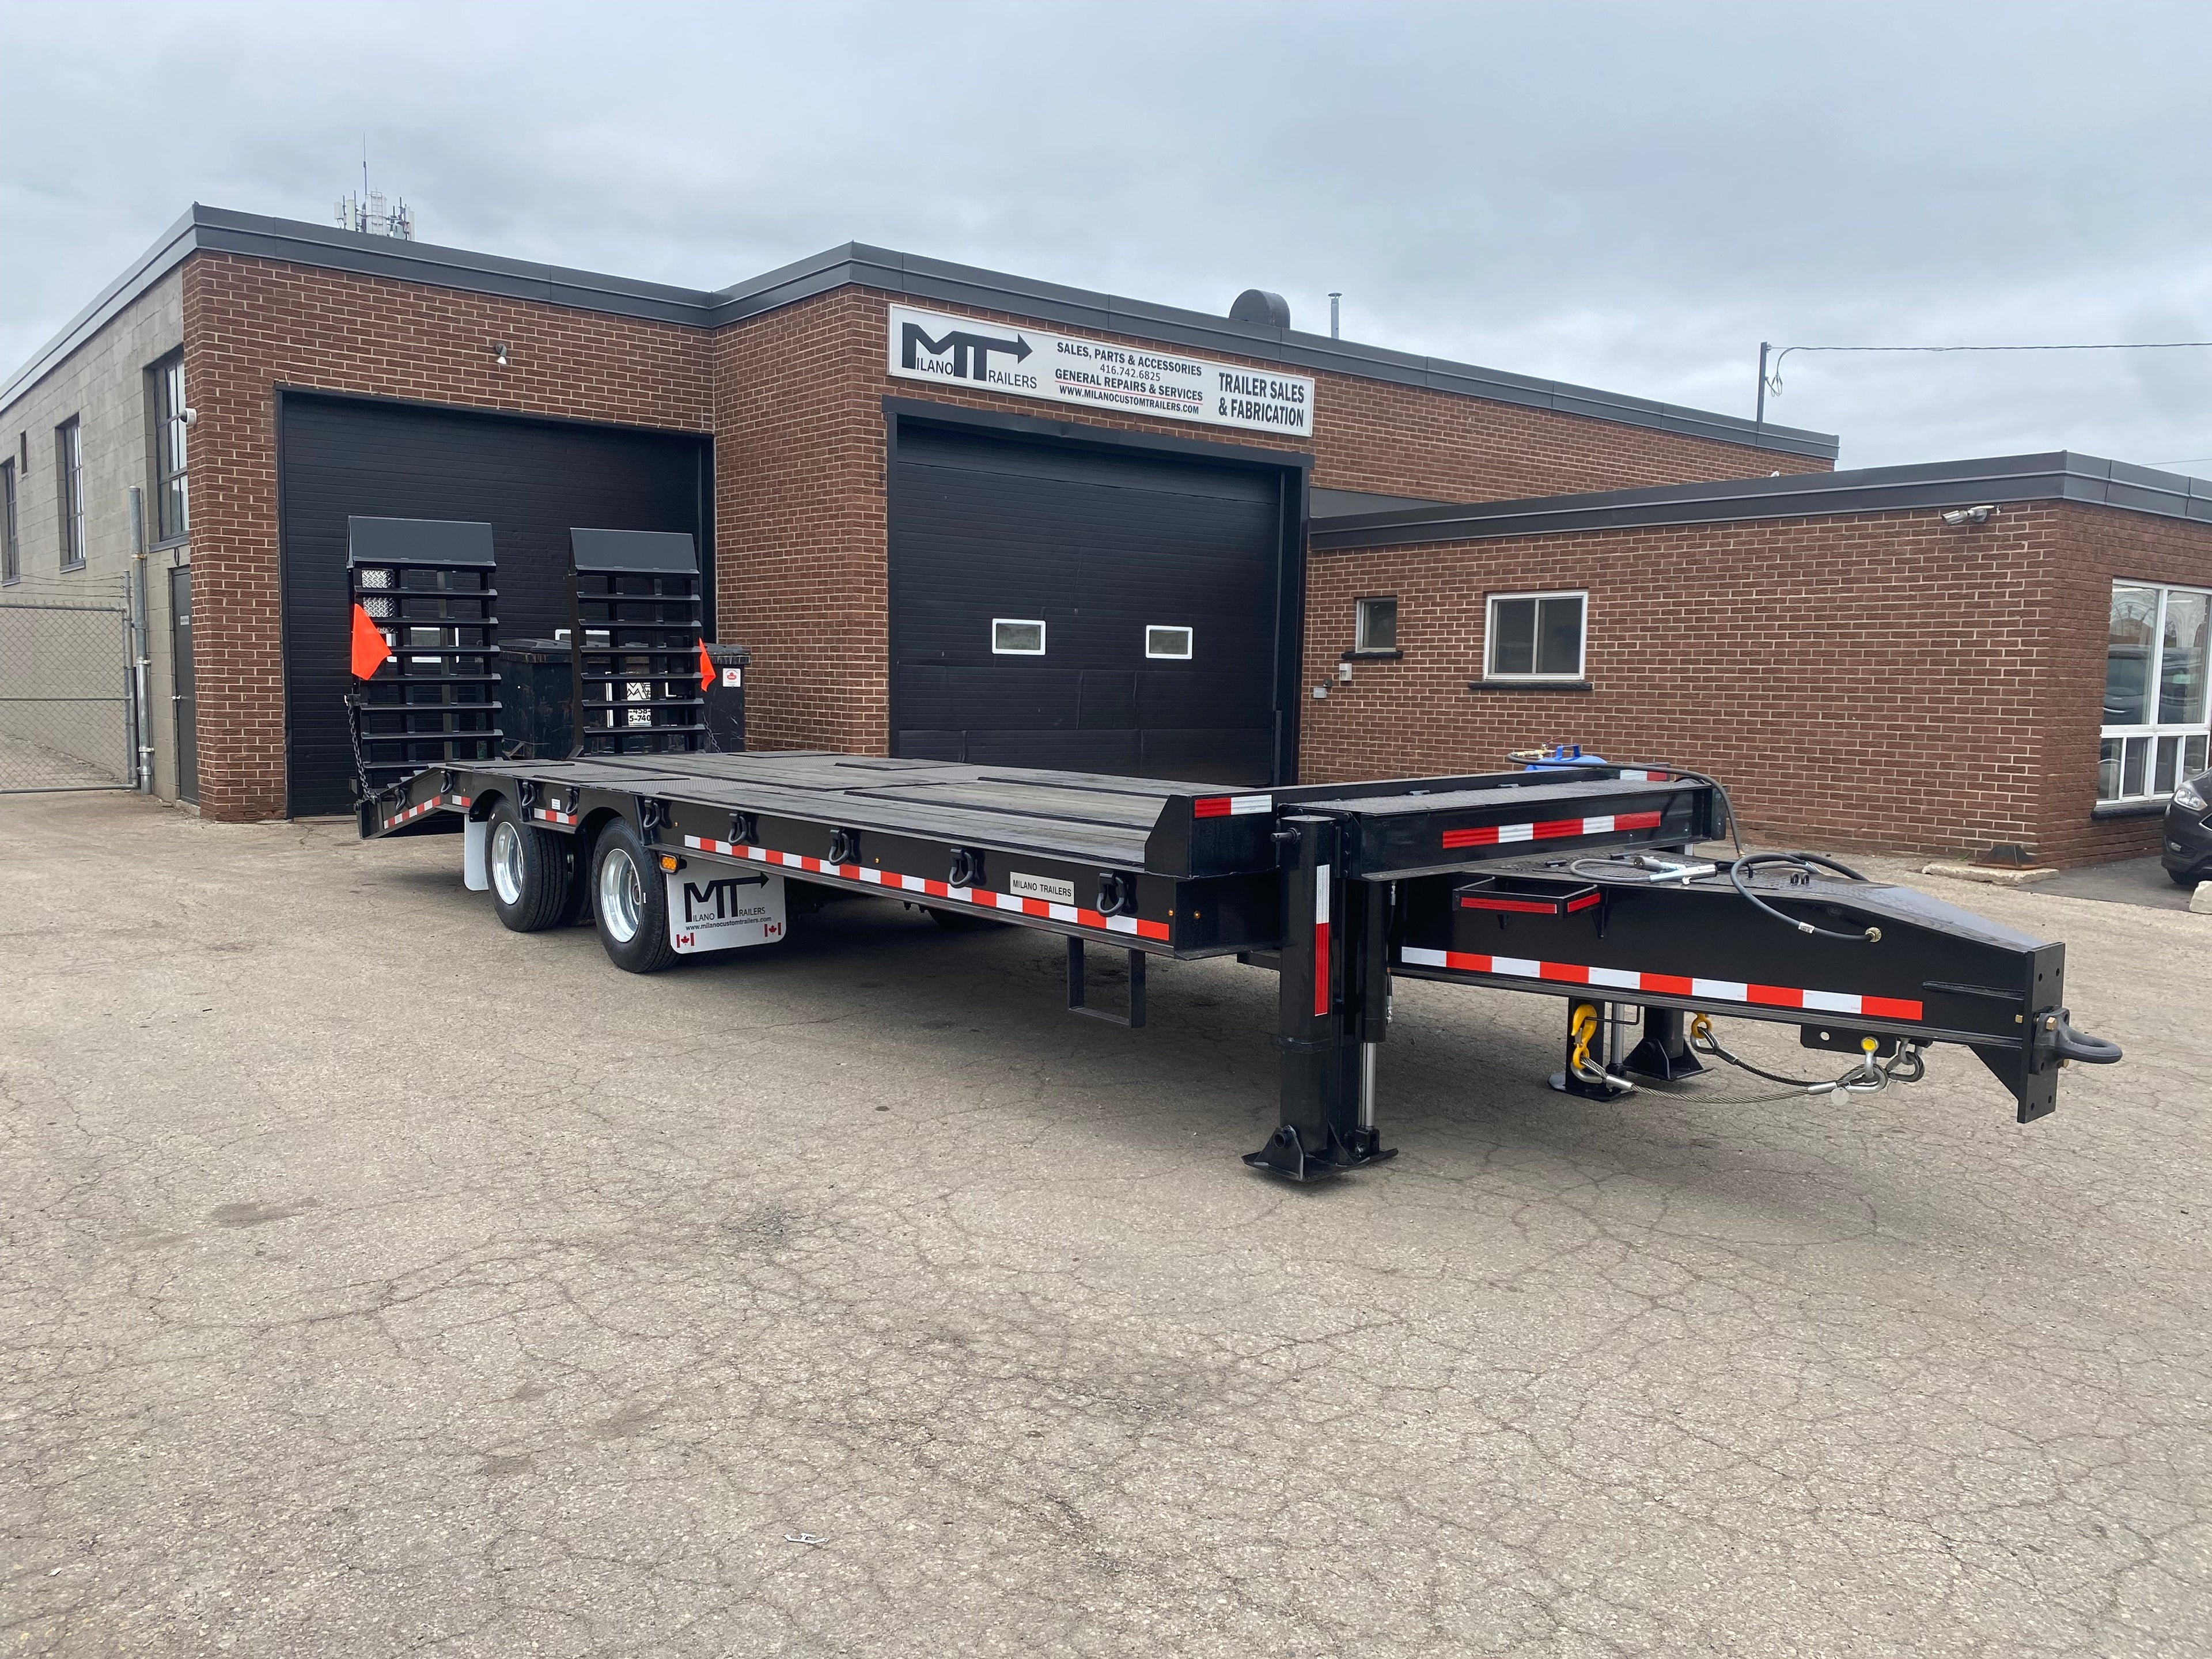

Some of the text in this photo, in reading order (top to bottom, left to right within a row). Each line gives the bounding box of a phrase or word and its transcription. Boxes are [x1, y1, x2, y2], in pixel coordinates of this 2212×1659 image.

[1057, 342, 1202, 376] SALES, PARTS & ACCESSORIES
[1100, 364, 1160, 381] 416.742.6825
[1055, 368, 1203, 401] GENERAL REPAIRS & SERVICES
[1219, 372, 1304, 403] TRAILER SALES
[1059, 385, 1199, 414] WWW.MILANOCUSTOMTRAILERS.COM
[1219, 397, 1304, 427] & FABRICATION
[1013, 880, 1071, 897] MILANO TRAILERS
[685, 916, 772, 931] www.milanocustomtrailers.com
